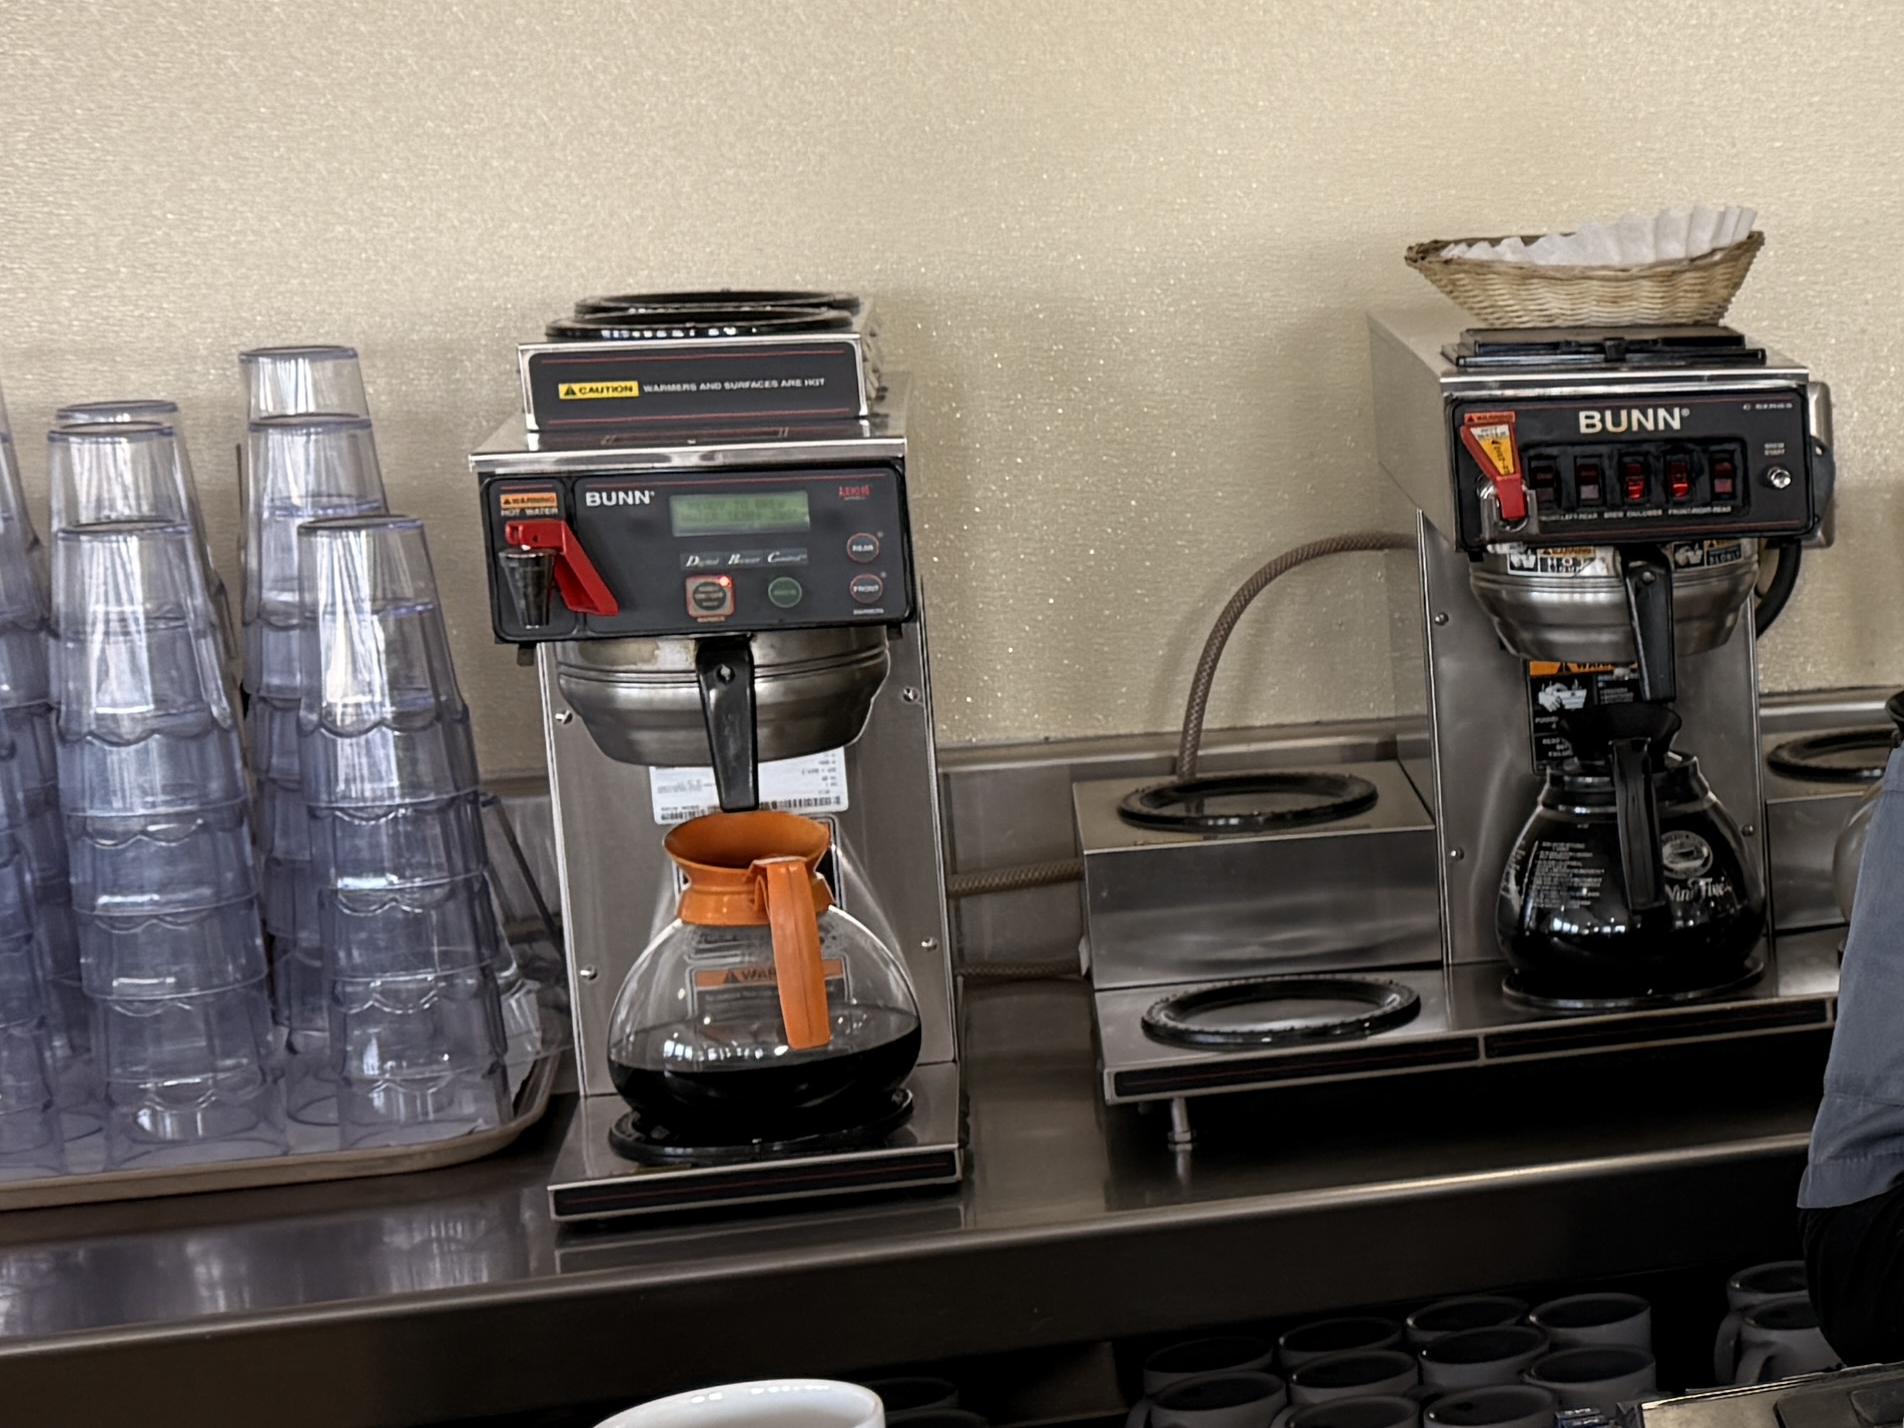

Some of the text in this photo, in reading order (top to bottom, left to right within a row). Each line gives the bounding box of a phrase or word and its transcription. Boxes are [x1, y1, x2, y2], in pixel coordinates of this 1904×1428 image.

[578, 383, 634, 397] CAUTION
[643, 382, 697, 394] WARMERS
[700, 381, 722, 391] AND
[724, 379, 779, 390] SURFACES
[804, 377, 826, 388] HOT
[1578, 406, 1683, 435] BUNN
[585, 491, 651, 507] BUNN
